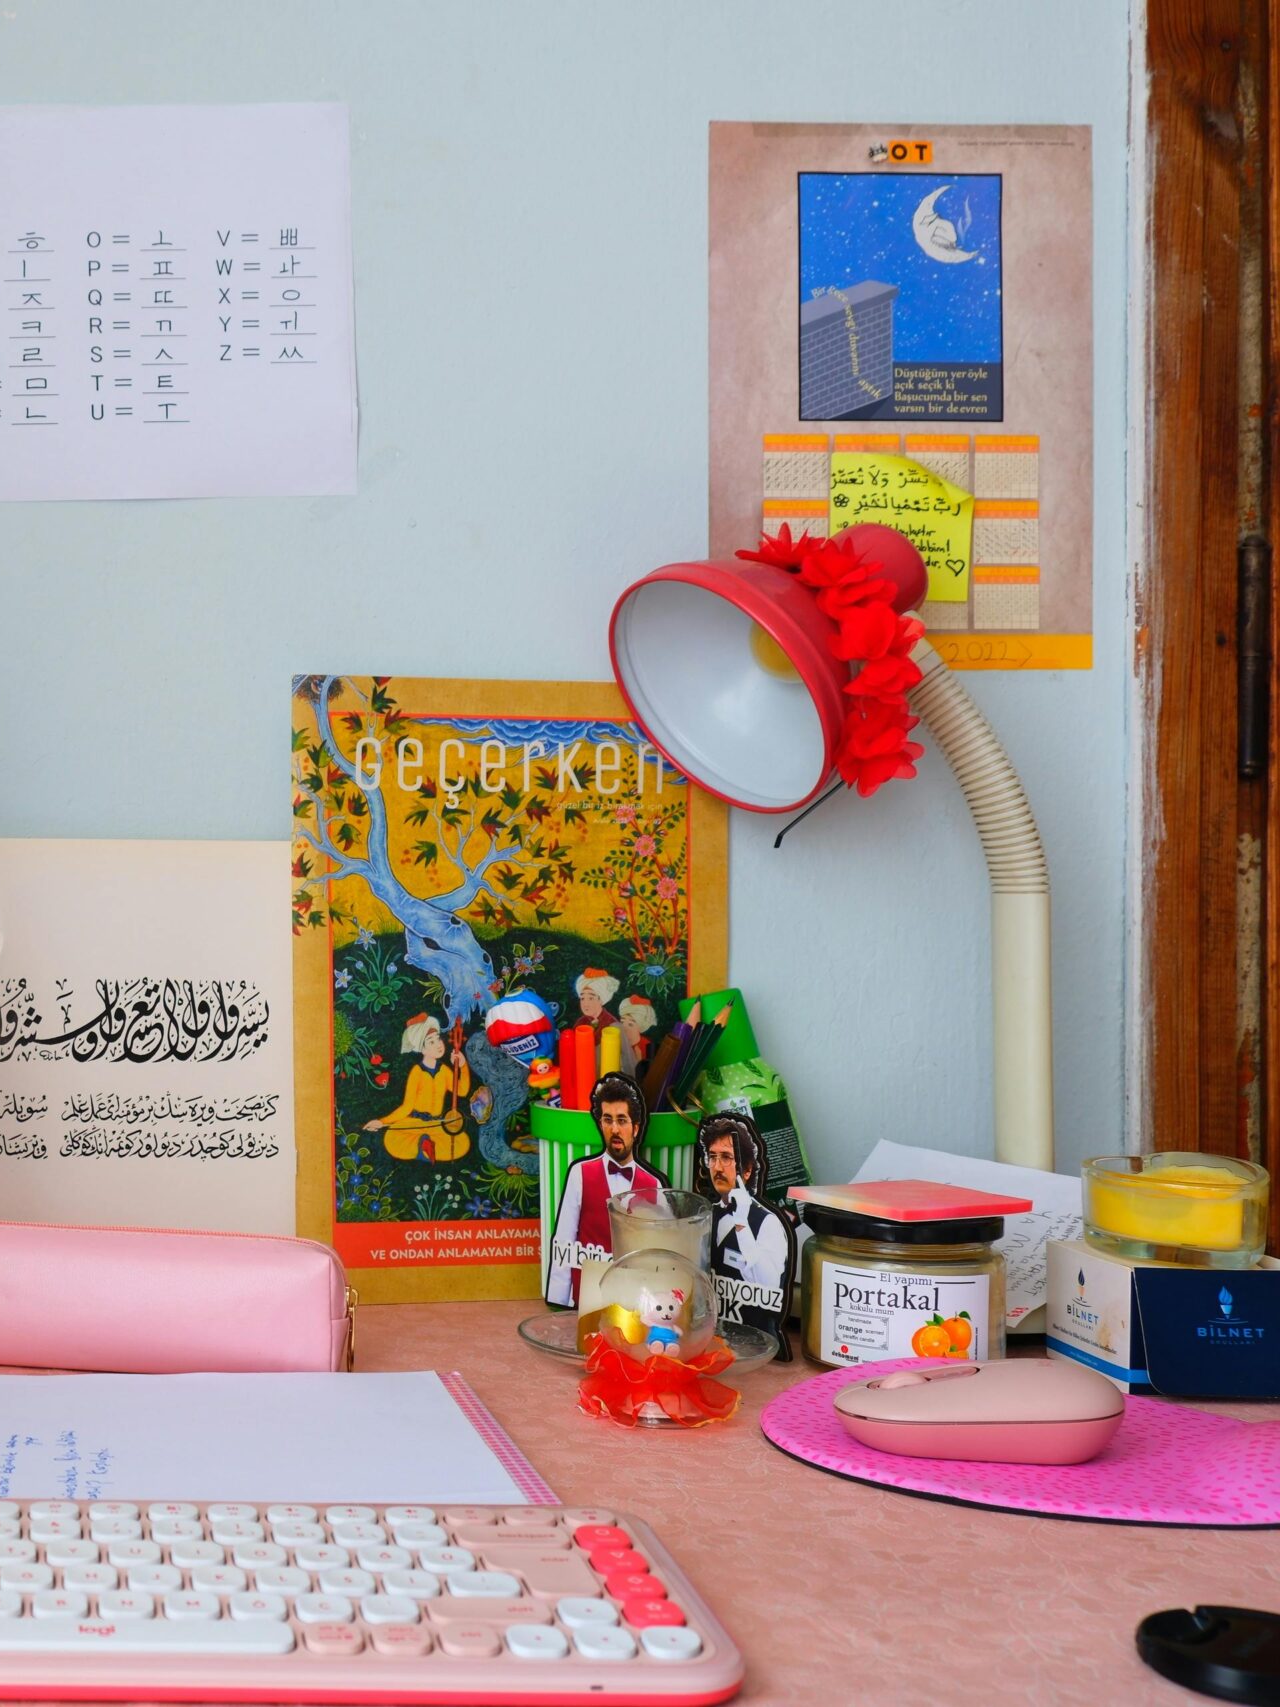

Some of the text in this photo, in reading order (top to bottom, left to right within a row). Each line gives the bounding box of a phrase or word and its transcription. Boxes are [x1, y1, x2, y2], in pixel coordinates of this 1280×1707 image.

[86, 230, 102, 249] O
[216, 229, 231, 248] V
[87, 259, 102, 278] P
[215, 258, 233, 277] W
[87, 288, 103, 307] Q
[217, 287, 232, 305] X
[88, 316, 103, 335] R
[218, 315, 232, 334] Y
[90, 345, 104, 364] S
[219, 344, 233, 362] Z
[90, 374, 105, 392] T
[894, 367, 988, 381] Düştüğüm yer öyle
[894, 380, 955, 391] açık seçik ki
[894, 391, 952, 403] Başucumda
[954, 391, 968, 401] bir
[90, 403, 105, 421] U
[894, 403, 988, 414] varsın bir de evren
[946, 641, 1017, 662] 2022
[405, 1231, 430, 1244] ÇOK
[434, 1228, 471, 1241] İNSAN
[370, 1249, 386, 1260] VE
[389, 1248, 434, 1259] ONDAN
[437, 1246, 512, 1258] ANLAMAYAN
[516, 1244, 534, 1257] BİR
[553, 1240, 571, 1267] iyi
[880, 1273, 932, 1287] El yapımı
[849, 1303, 895, 1316] kokulu mum
[1066, 1303, 1099, 1325] BİLNET
[838, 1324, 863, 1334] orange
[1196, 1324, 1265, 1338] BİLNET
[78, 1624, 116, 1637] logi
